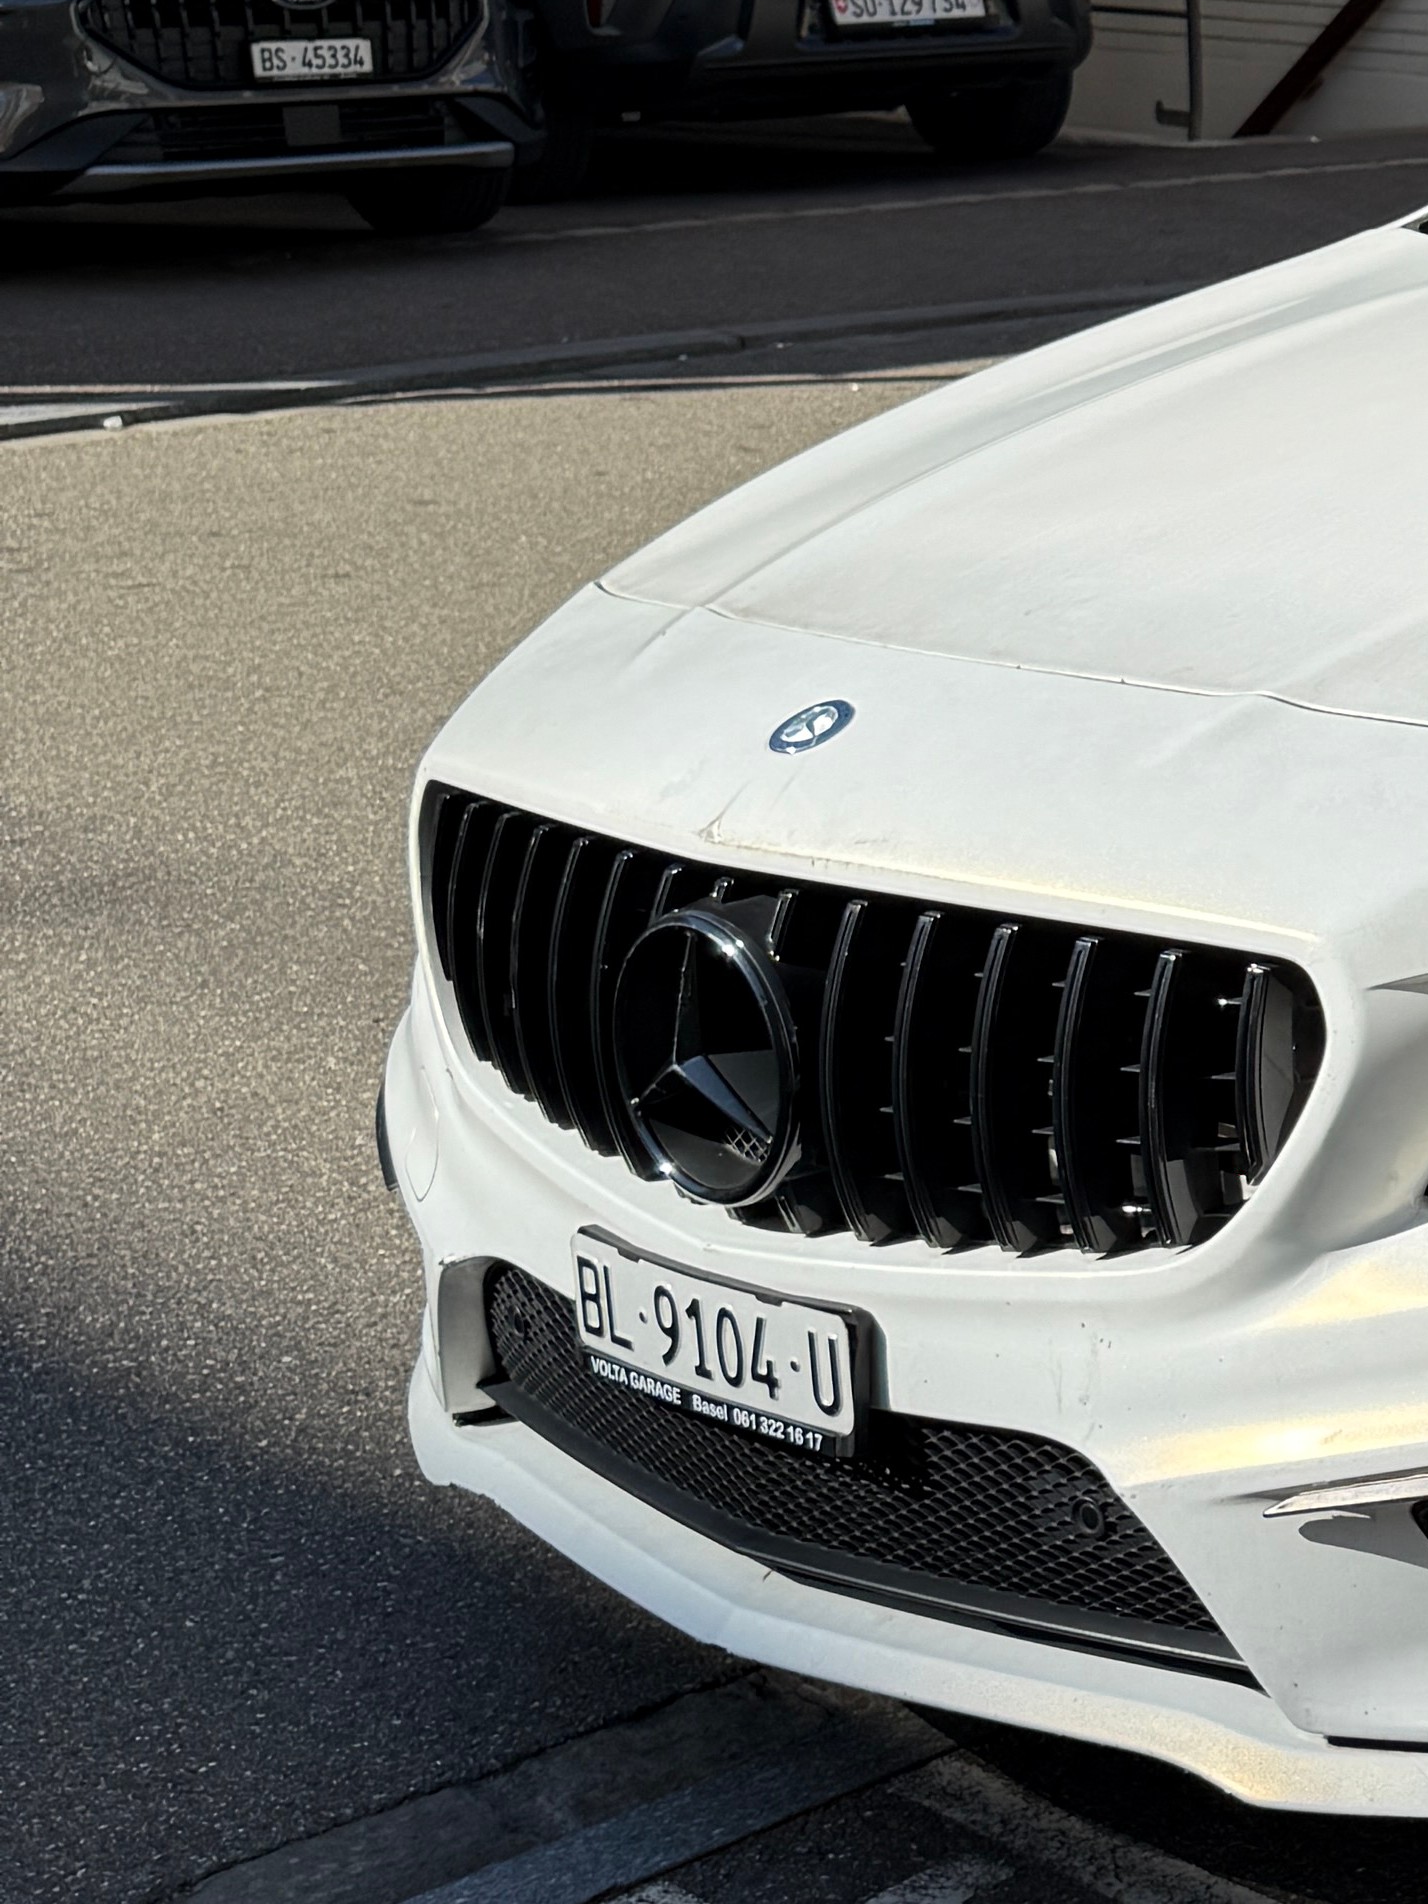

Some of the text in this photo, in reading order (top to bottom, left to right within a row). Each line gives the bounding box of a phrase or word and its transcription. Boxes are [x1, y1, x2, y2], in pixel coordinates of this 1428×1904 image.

[591, 1355, 628, 1386] VOLTA
[630, 1371, 682, 1405] GARAGE
[692, 1394, 728, 1422] Basel
[759, 1416, 785, 1439] 322
[787, 1427, 804, 1446] 16
[806, 1432, 823, 1452] 17
